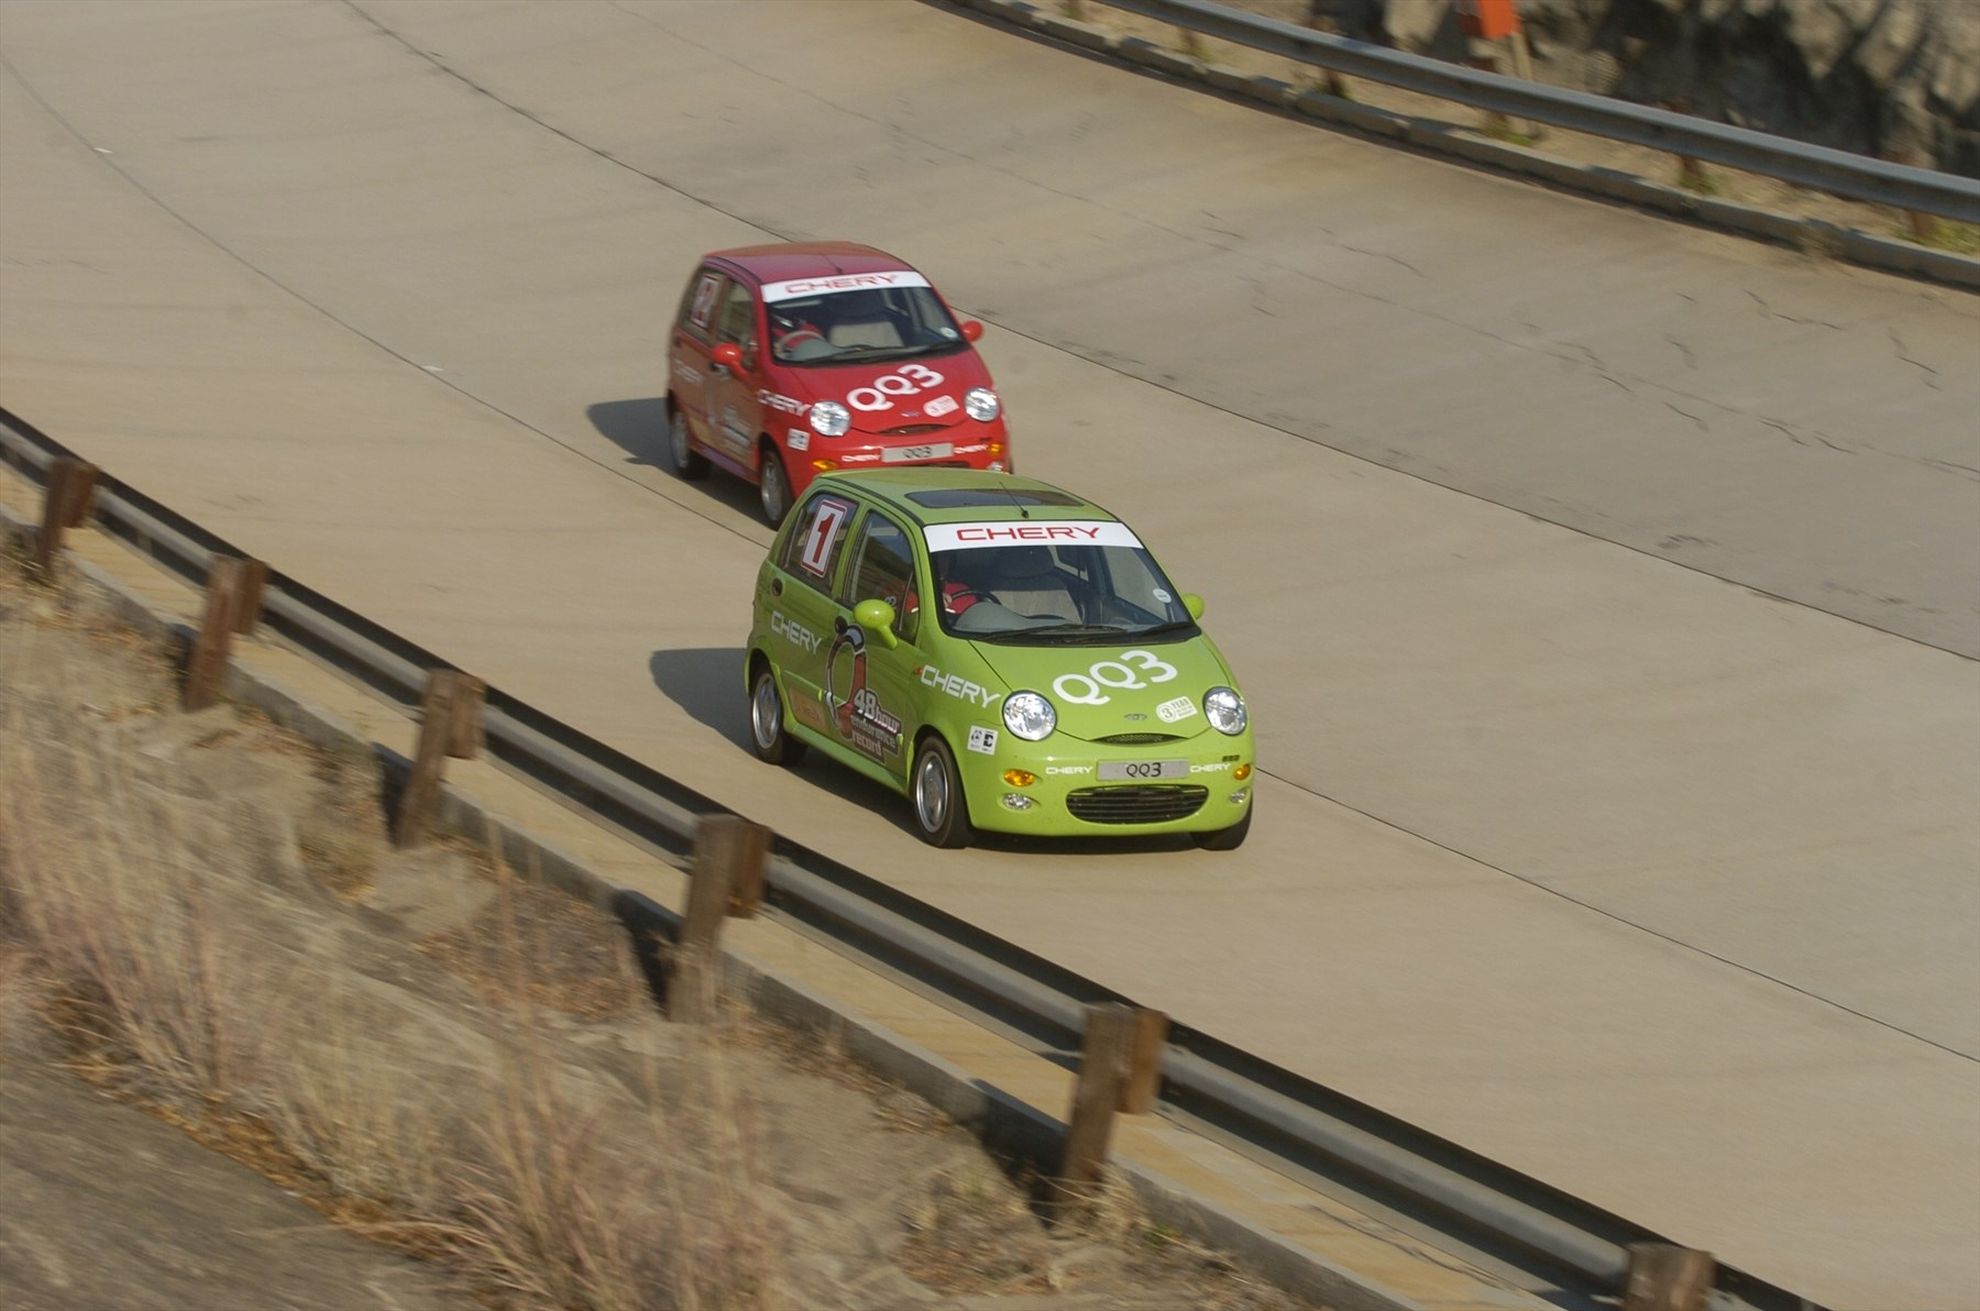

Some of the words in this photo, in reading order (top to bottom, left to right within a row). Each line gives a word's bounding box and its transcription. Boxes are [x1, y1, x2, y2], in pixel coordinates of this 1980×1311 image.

[785, 274, 898, 294] CHERY
[847, 364, 945, 412] QQ3
[811, 512, 836, 564] 1
[956, 526, 1100, 542] CHERY
[771, 610, 823, 656] CHERY
[920, 664, 1001, 709] CHERY
[1052, 650, 1179, 706] QQ3
[1160, 707, 1174, 719] 3
[852, 729, 882, 757] record
[1045, 765, 1094, 775] CHERY
[1125, 762, 1162, 777] QQ3
[1189, 763, 1232, 774] CHERY
